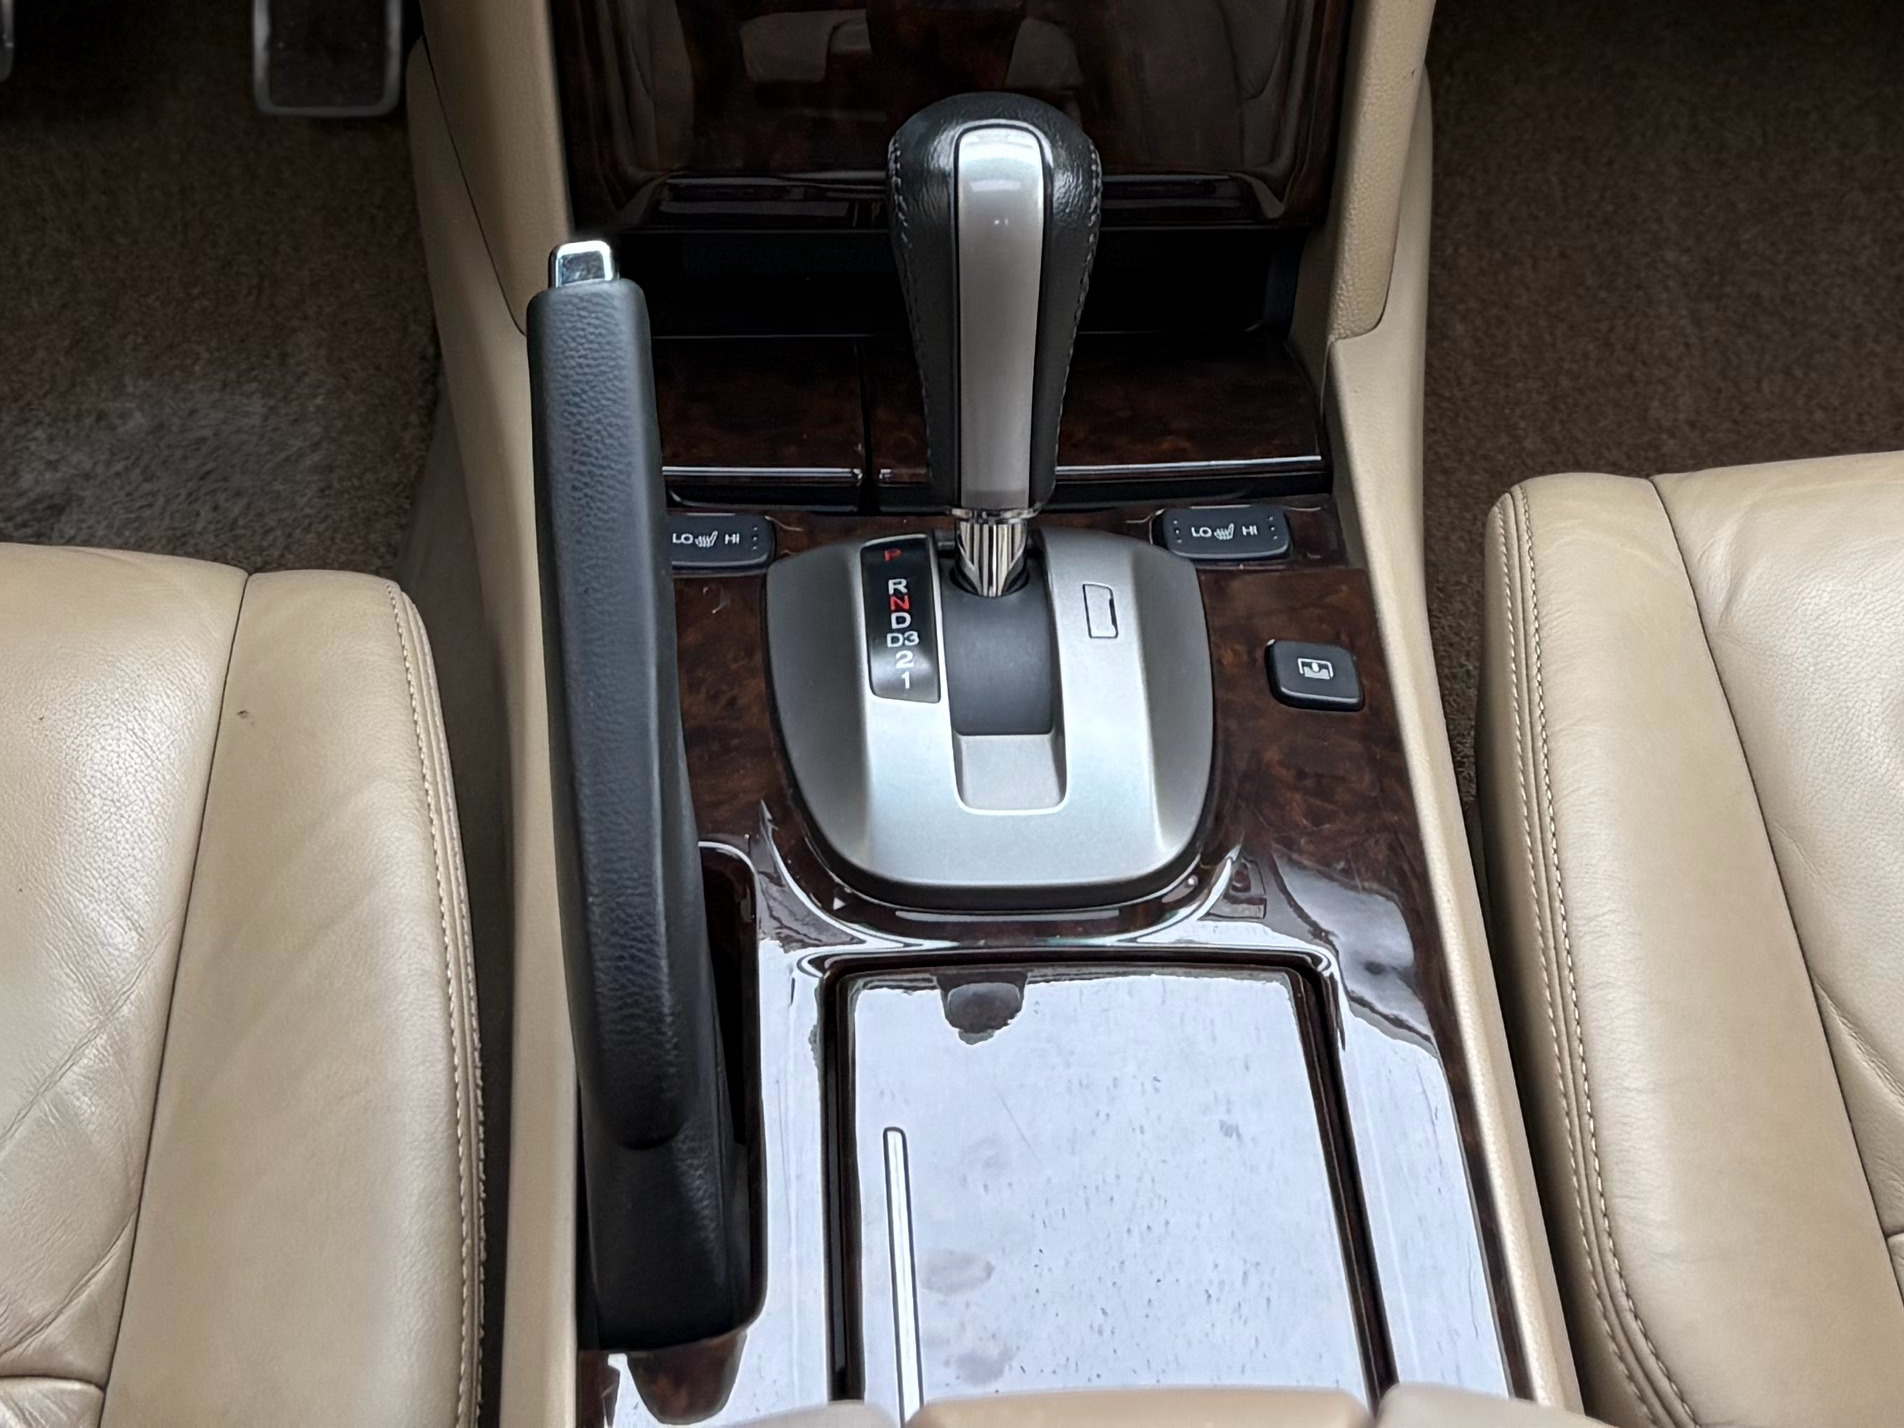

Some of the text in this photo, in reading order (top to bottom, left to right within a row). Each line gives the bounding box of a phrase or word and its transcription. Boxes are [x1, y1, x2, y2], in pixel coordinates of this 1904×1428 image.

[672, 532, 740, 544] LO HI
[1191, 525, 1258, 538] LO HI
[883, 547, 902, 562] P
[888, 578, 908, 595] R
[890, 595, 911, 611] N
[890, 612, 912, 629] D
[886, 630, 920, 648] D3
[895, 650, 915, 669] 2
[901, 671, 911, 690] 1
